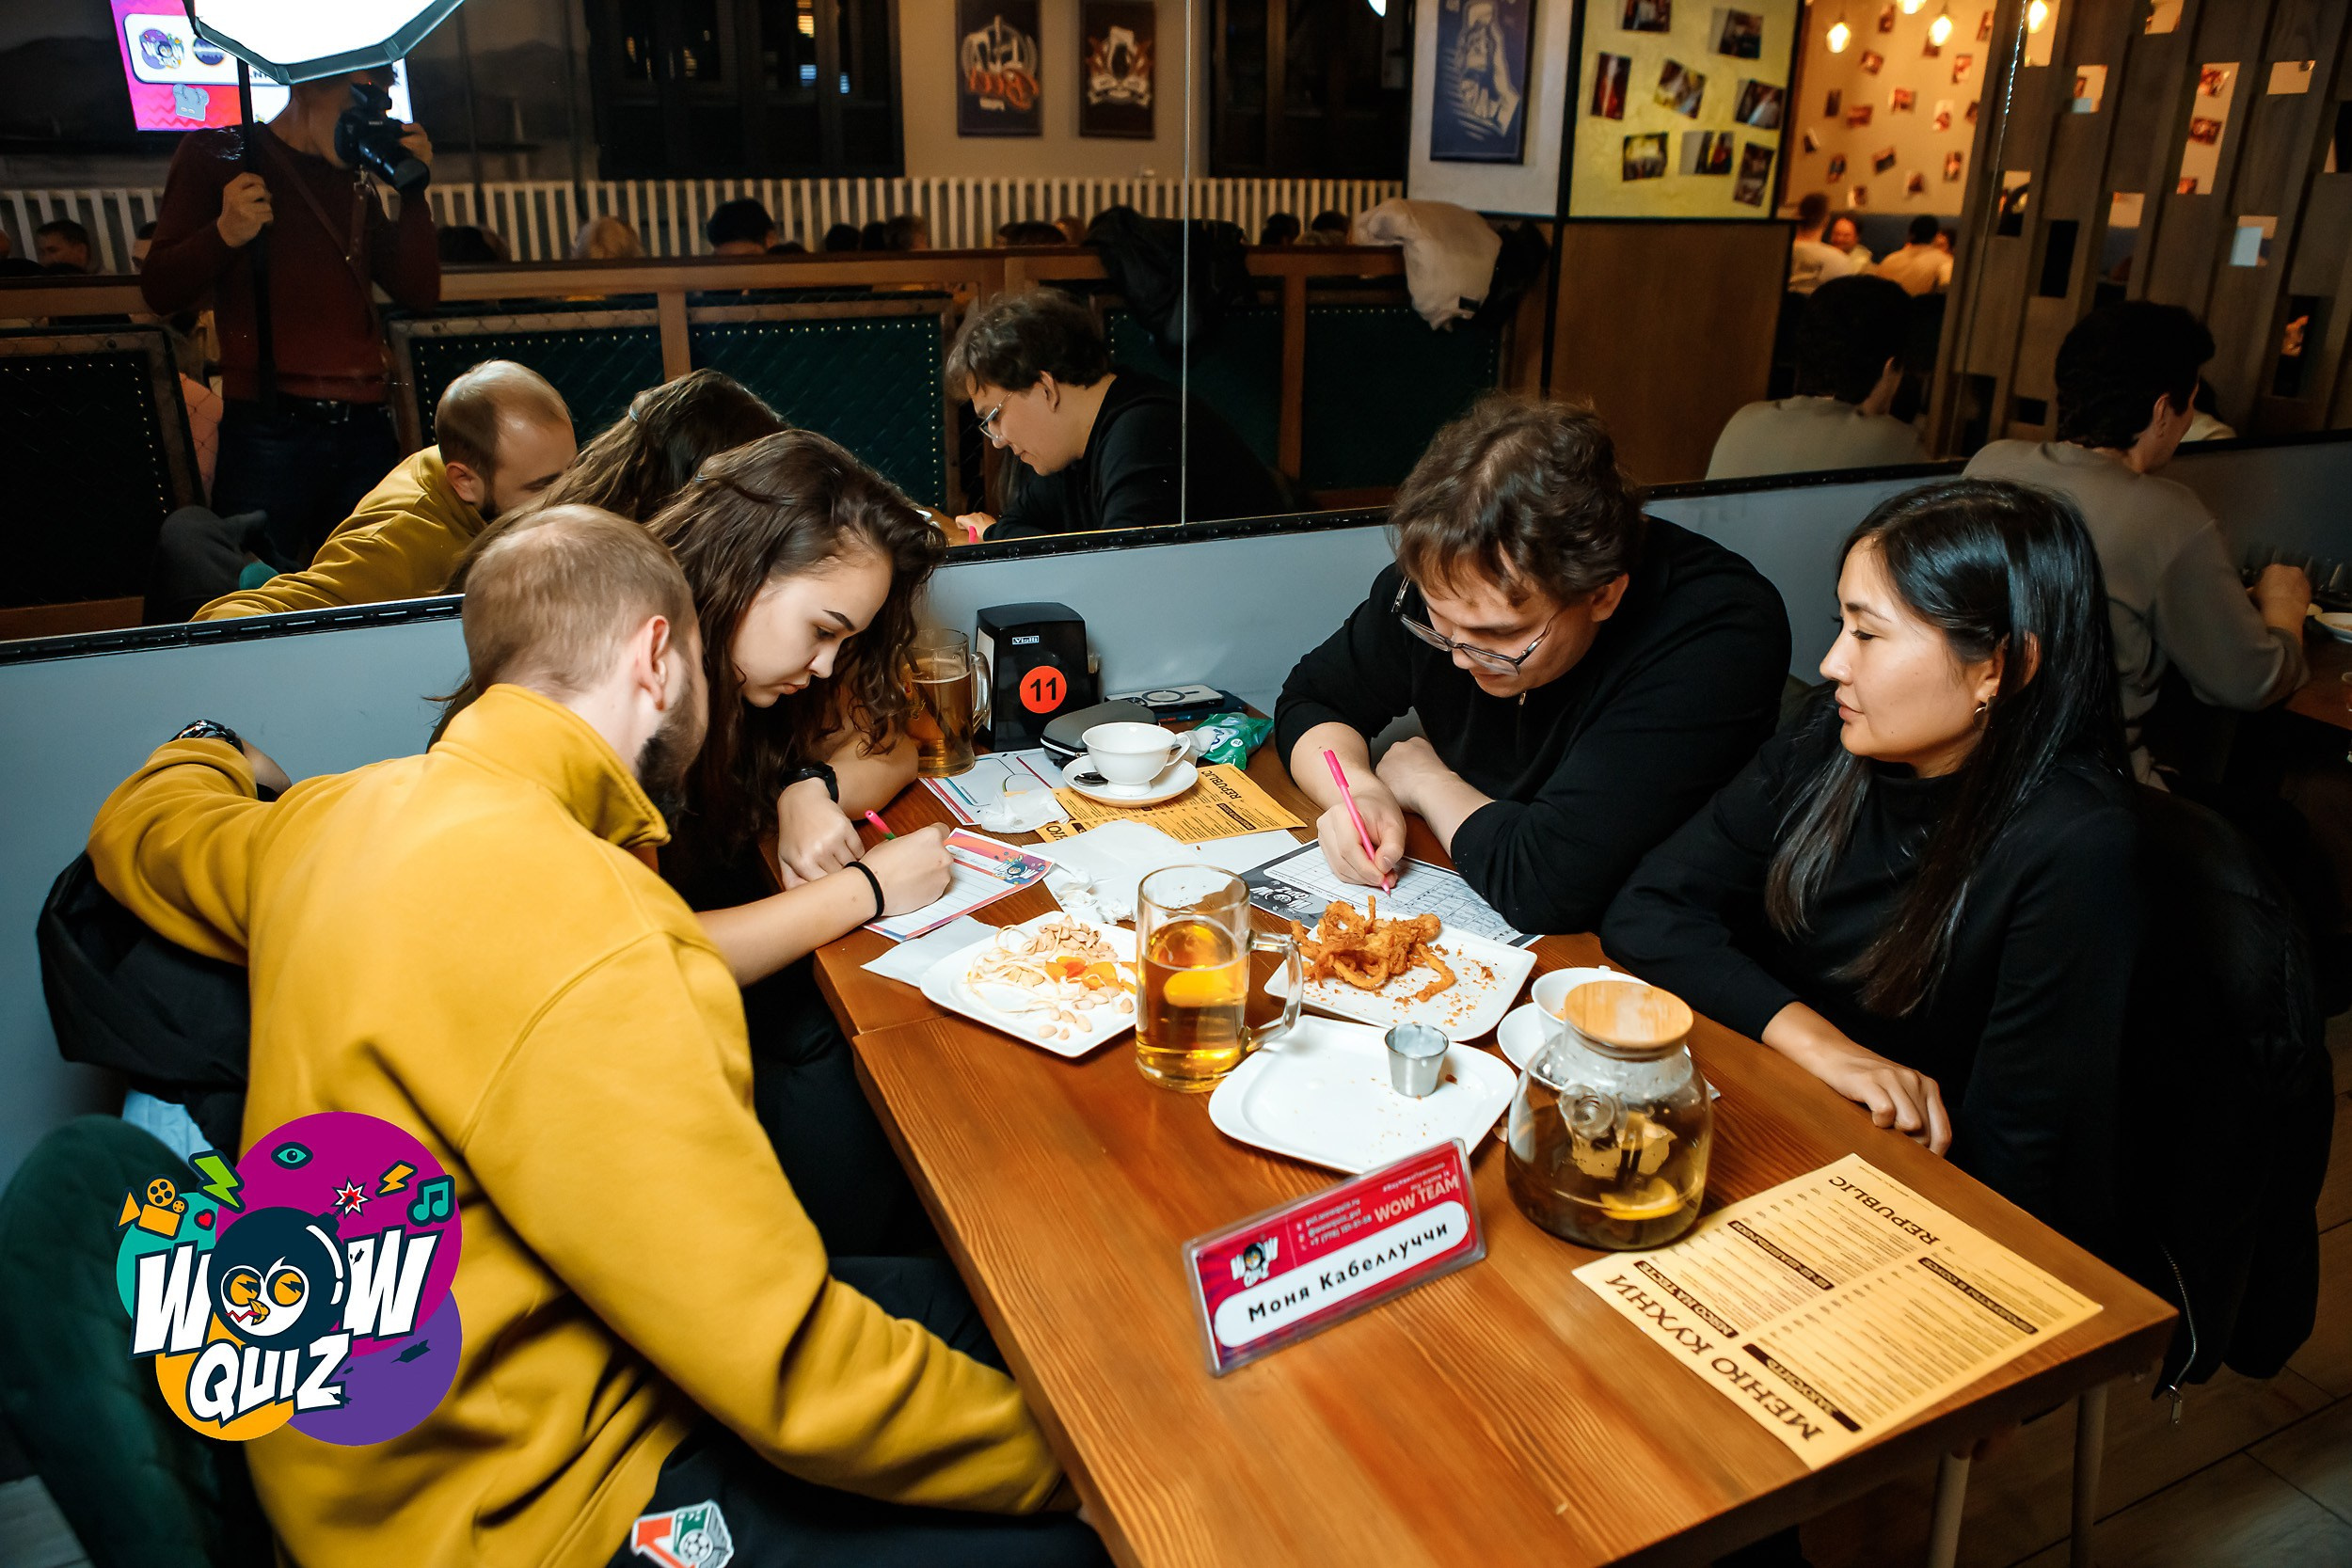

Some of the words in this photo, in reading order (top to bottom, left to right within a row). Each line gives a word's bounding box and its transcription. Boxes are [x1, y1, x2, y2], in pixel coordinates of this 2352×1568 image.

[1029, 677, 1057, 702] 11
[1200, 769, 1243, 799] REPUBLIC
[1374, 1192, 1417, 1224] WOW
[1415, 1174, 1460, 1205] TEAM
[1828, 1176, 1940, 1245] REPUBLIC
[1230, 1235, 1278, 1280] WOW
[1247, 1286, 1311, 1323] Моня
[1320, 1221, 1449, 1290] Кабеллуччи
[1605, 1274, 1714, 1355] КУХНИ
[1713, 1355, 1823, 1442] МЕНЮ
